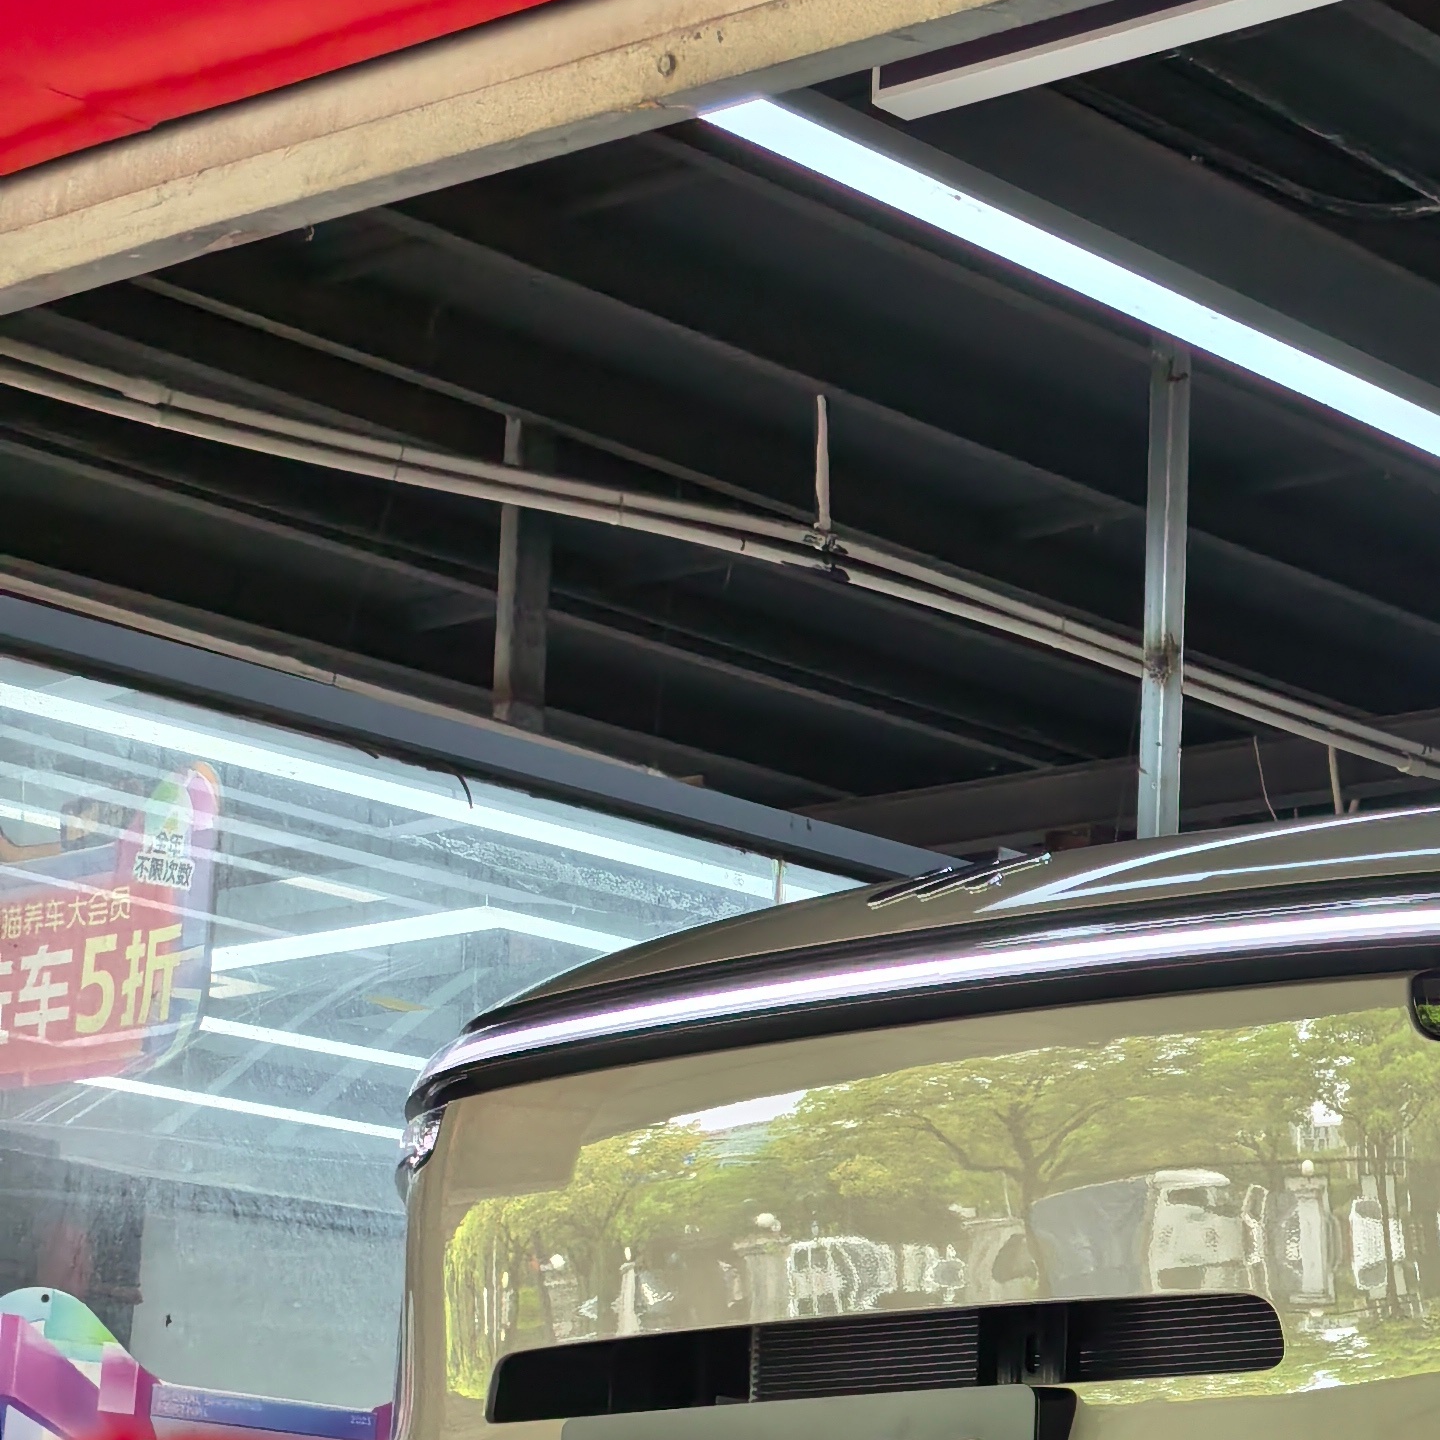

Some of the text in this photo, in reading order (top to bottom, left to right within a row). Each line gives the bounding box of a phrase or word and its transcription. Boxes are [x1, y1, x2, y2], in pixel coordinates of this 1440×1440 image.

[134, 856, 194, 888] 不限次数
[0, 923, 190, 1043] 车5折
